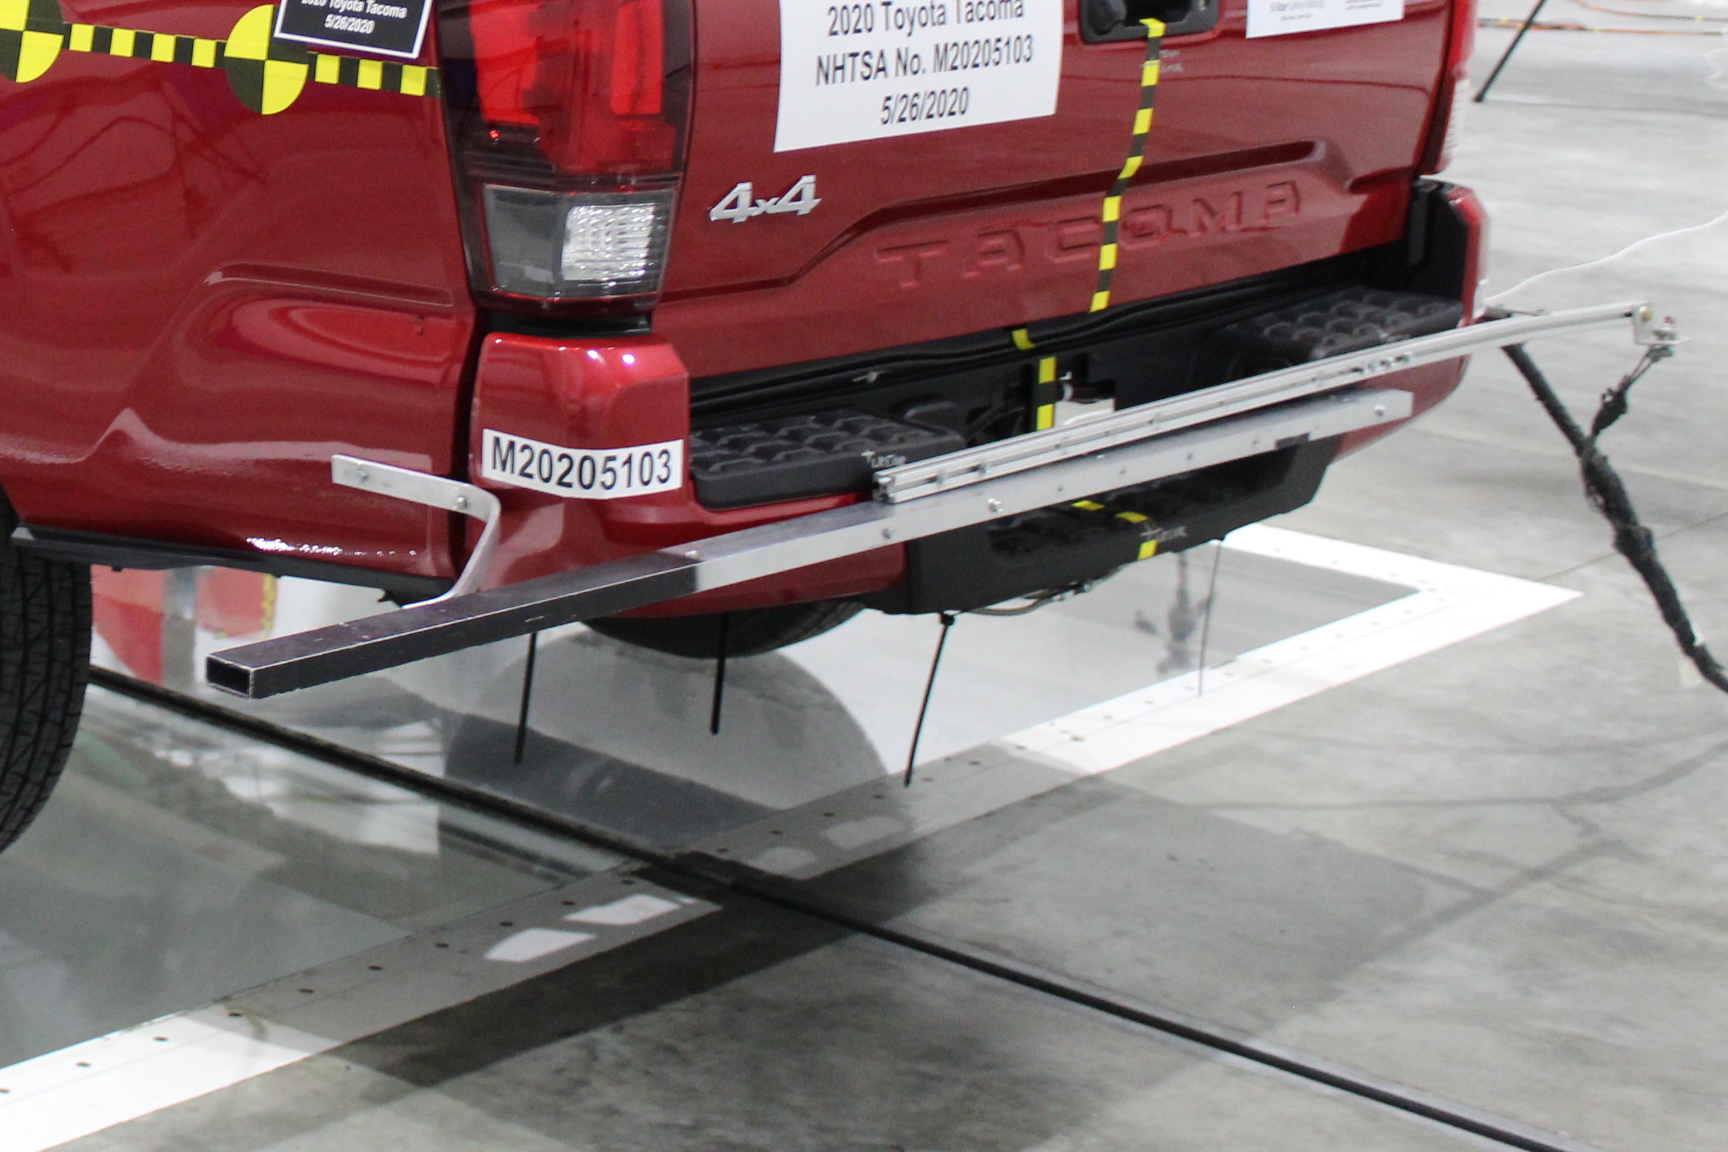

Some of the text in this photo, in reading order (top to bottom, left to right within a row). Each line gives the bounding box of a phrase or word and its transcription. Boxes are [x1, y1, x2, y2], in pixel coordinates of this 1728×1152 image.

[324, 14, 375, 34] 5/26/2020
[365, 0, 407, 19] Tacoma
[827, 2, 875, 37] 2020
[815, 34, 1034, 87] NHTSA No. M20205103
[880, 86, 970, 125] 5/26/2020
[709, 174, 822, 223] 4x4
[875, 180, 1301, 289] TACOMA
[491, 436, 672, 491] M20205103
